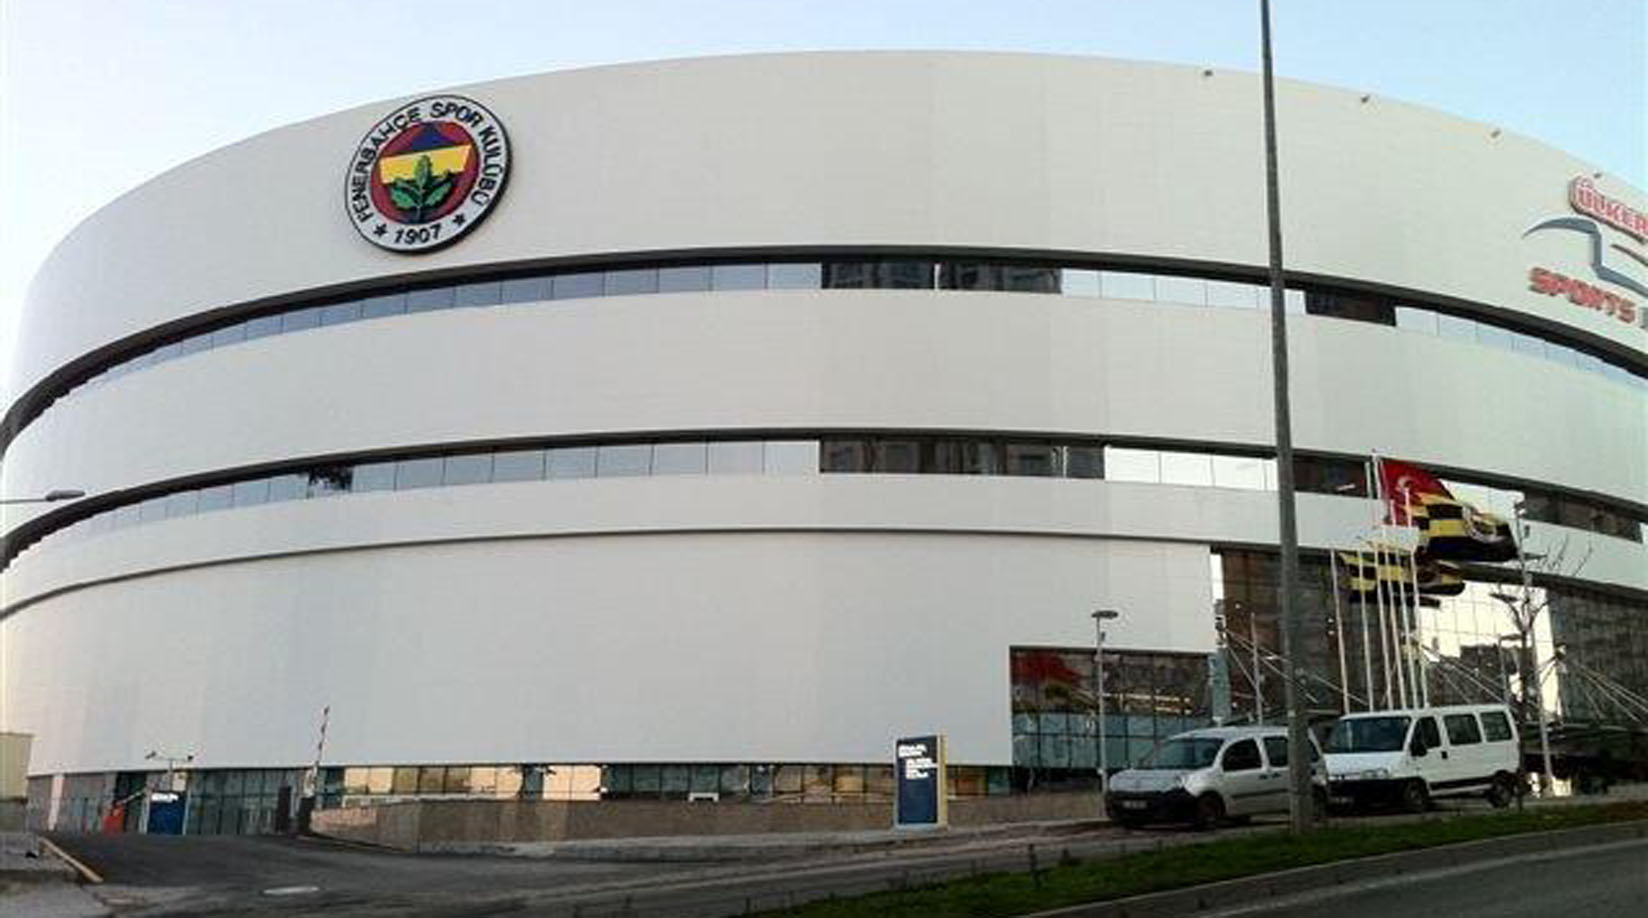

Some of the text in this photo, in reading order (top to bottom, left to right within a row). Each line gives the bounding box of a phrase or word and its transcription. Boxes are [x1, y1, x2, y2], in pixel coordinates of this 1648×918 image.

[429, 101, 484, 128] SPOR
[394, 223, 442, 245] 1907
[1528, 266, 1637, 324] SPORTS
